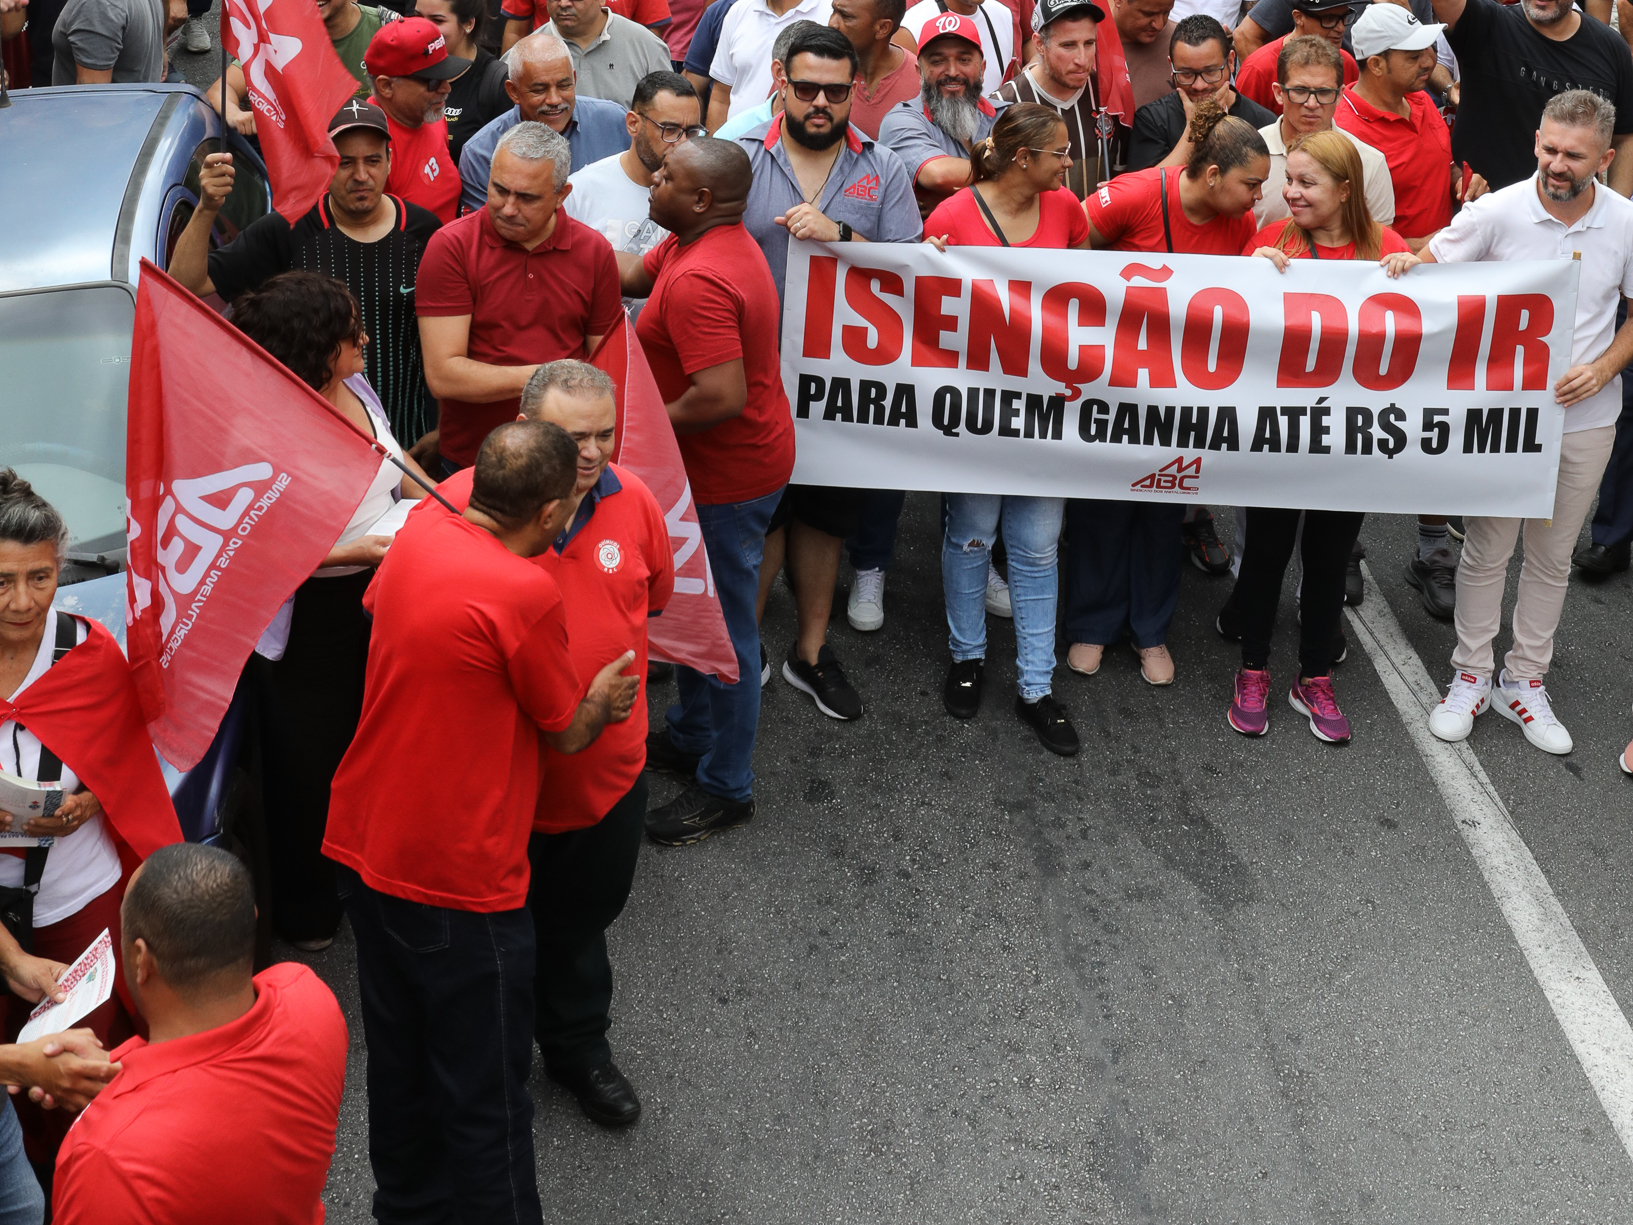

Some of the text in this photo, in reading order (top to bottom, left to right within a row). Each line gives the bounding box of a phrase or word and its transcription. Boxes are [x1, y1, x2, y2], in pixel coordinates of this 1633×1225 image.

[423, 156, 440, 182] 13
[843, 182, 879, 199] ABC
[801, 255, 1556, 403] ISENÇÃO DO IR
[796, 373, 1543, 460] PARA QUEM GANHA ATÉ R$ 5 MIL
[1130, 472, 1201, 491] ABC
